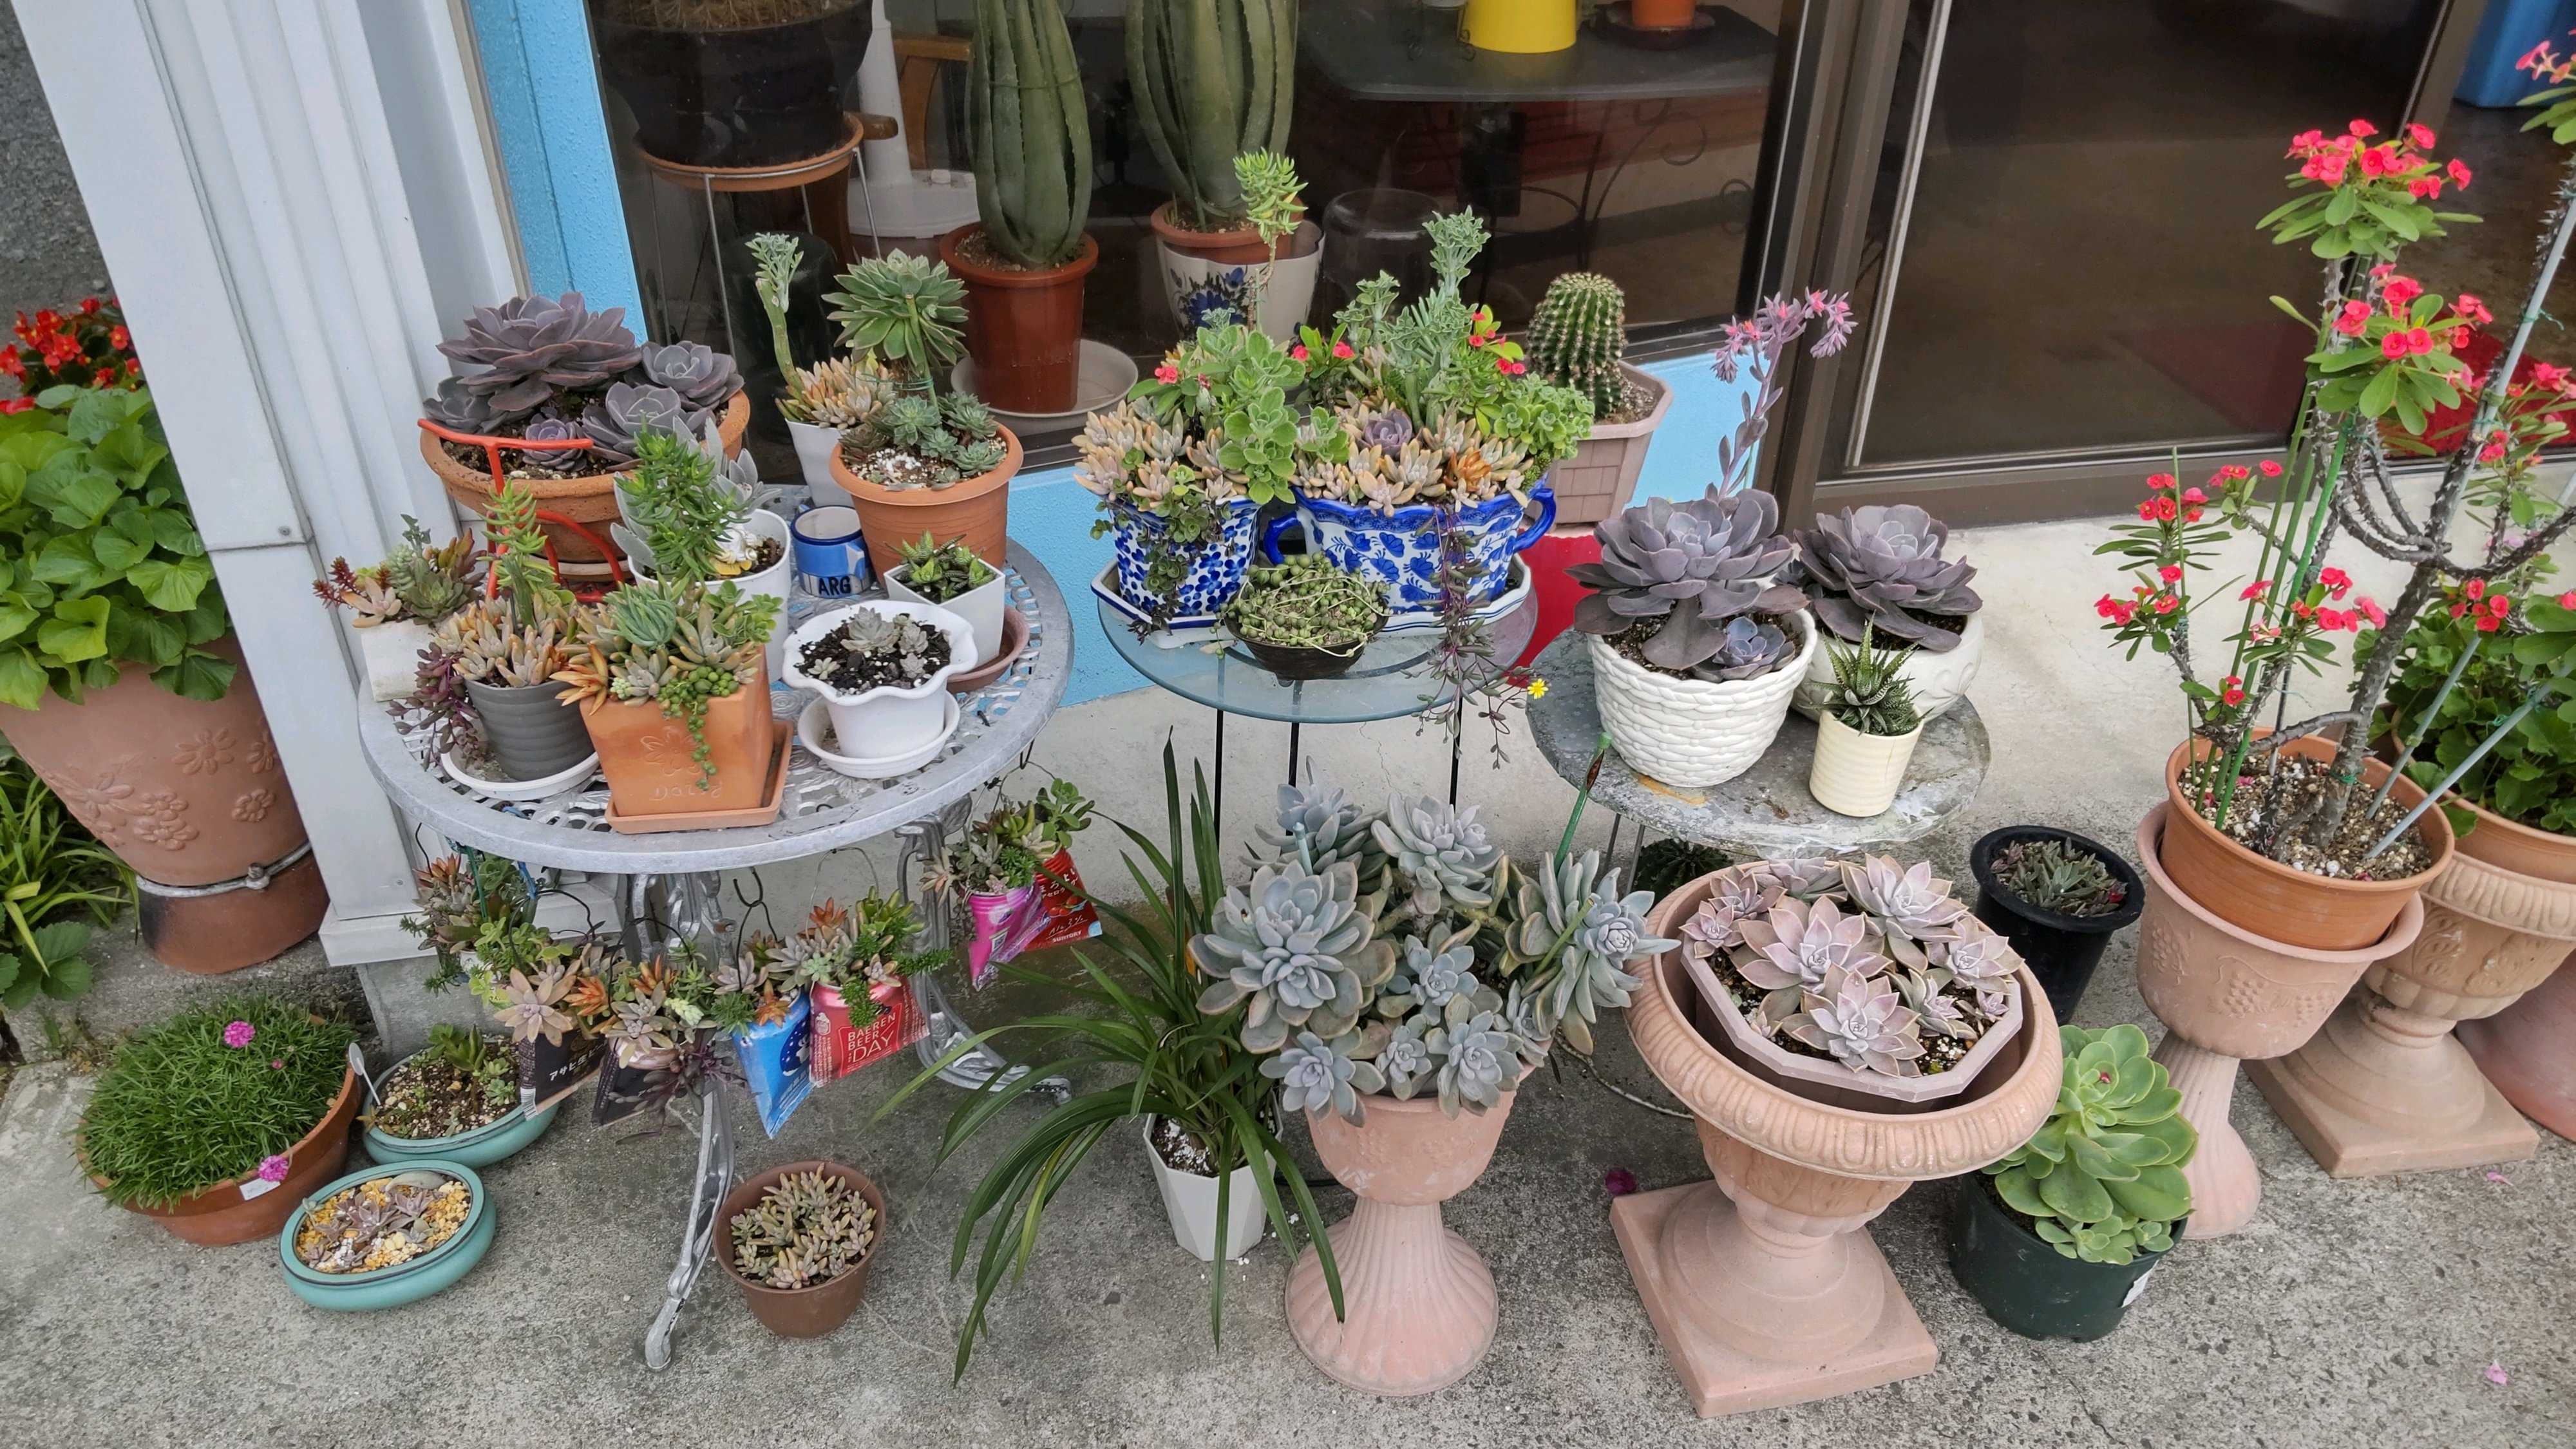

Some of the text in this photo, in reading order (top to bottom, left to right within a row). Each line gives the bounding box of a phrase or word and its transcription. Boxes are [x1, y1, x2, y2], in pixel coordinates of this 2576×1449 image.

[819, 576, 852, 596] ARG
[1052, 930, 1083, 943] SUNTORY
[848, 1012, 896, 1042] BAEREN
[848, 1030, 880, 1051] BEER
[853, 1030, 895, 1063] DAY
